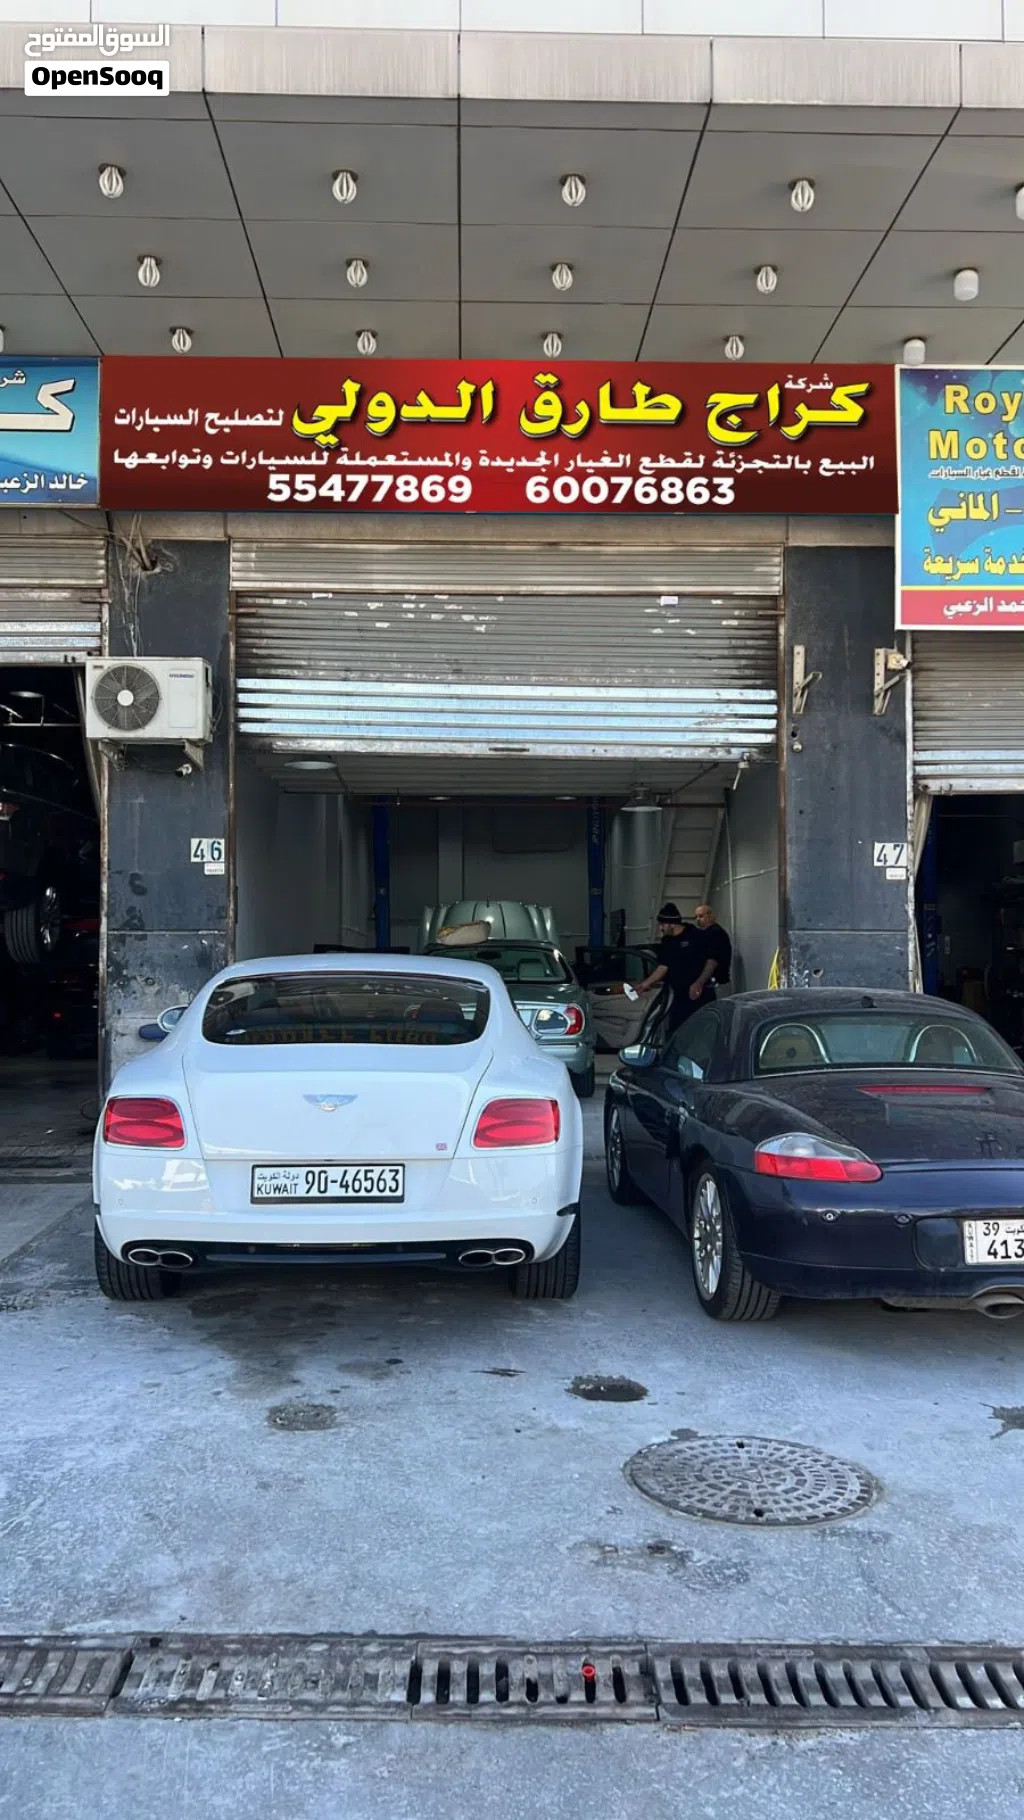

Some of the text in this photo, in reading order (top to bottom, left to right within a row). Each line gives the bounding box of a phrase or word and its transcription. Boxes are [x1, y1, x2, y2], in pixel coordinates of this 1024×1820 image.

[784, 373, 834, 391] شركة
[292, 373, 870, 448] كراج طارق الدولي
[944, 384, 1022, 422] Roy
[114, 407, 284, 435] لتصليح السيارات
[113, 447, 875, 477] البيع بالتجزئة لقطع الغيار الجديدة والمستعملة للسيارات وتوابعها
[49, 472, 89, 490] خالد
[266, 474, 473, 503] 55477869
[525, 476, 736, 505] 60076863
[927, 491, 999, 533] الماني
[923, 547, 980, 580] سريعة
[943, 597, 994, 619] الزعبي
[193, 839, 222, 861] 46
[876, 844, 904, 865] 47
[256, 1183, 299, 1195] KUWAIT
[305, 1169, 400, 1194] 90-46563
[983, 1222, 1000, 1236] 39
[987, 1239, 1024, 1259] 413
